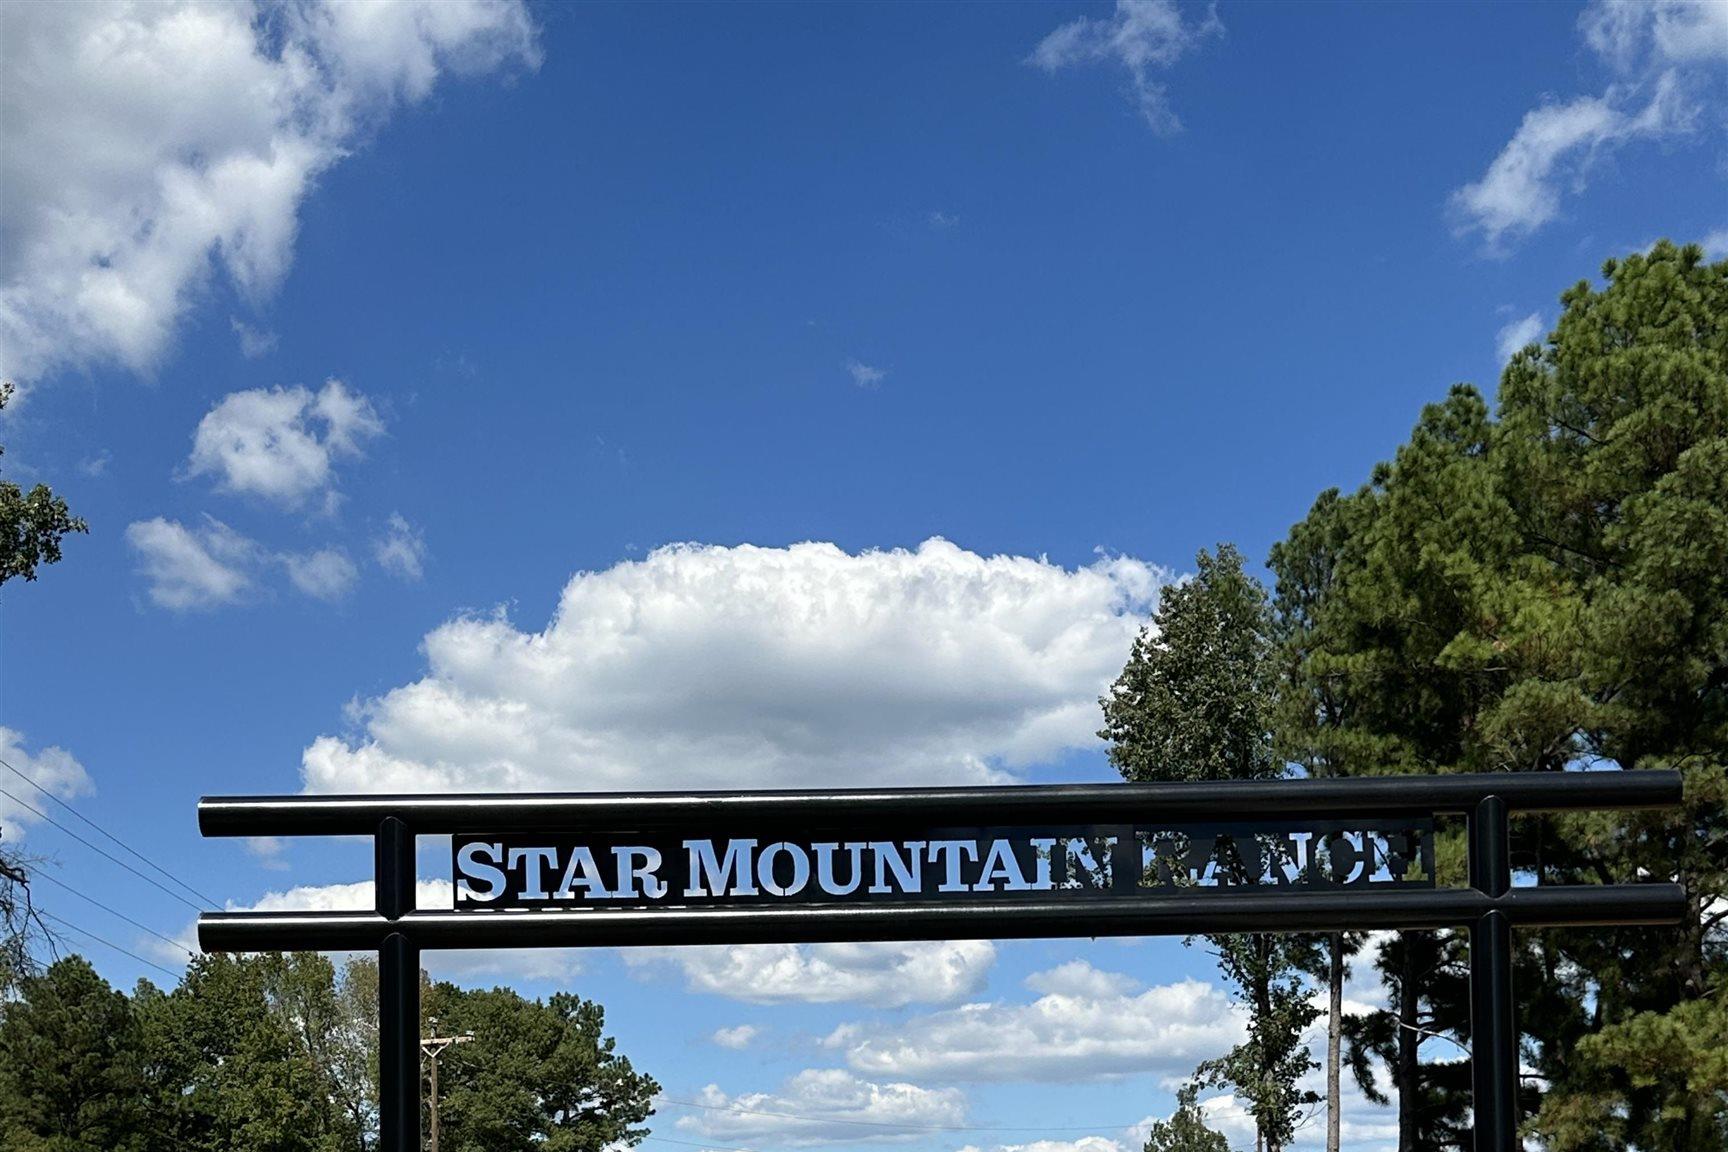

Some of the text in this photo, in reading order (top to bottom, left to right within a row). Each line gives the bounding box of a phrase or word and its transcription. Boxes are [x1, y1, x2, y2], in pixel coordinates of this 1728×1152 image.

[457, 830, 1429, 901] STAR MOUNTAIN RANCH
